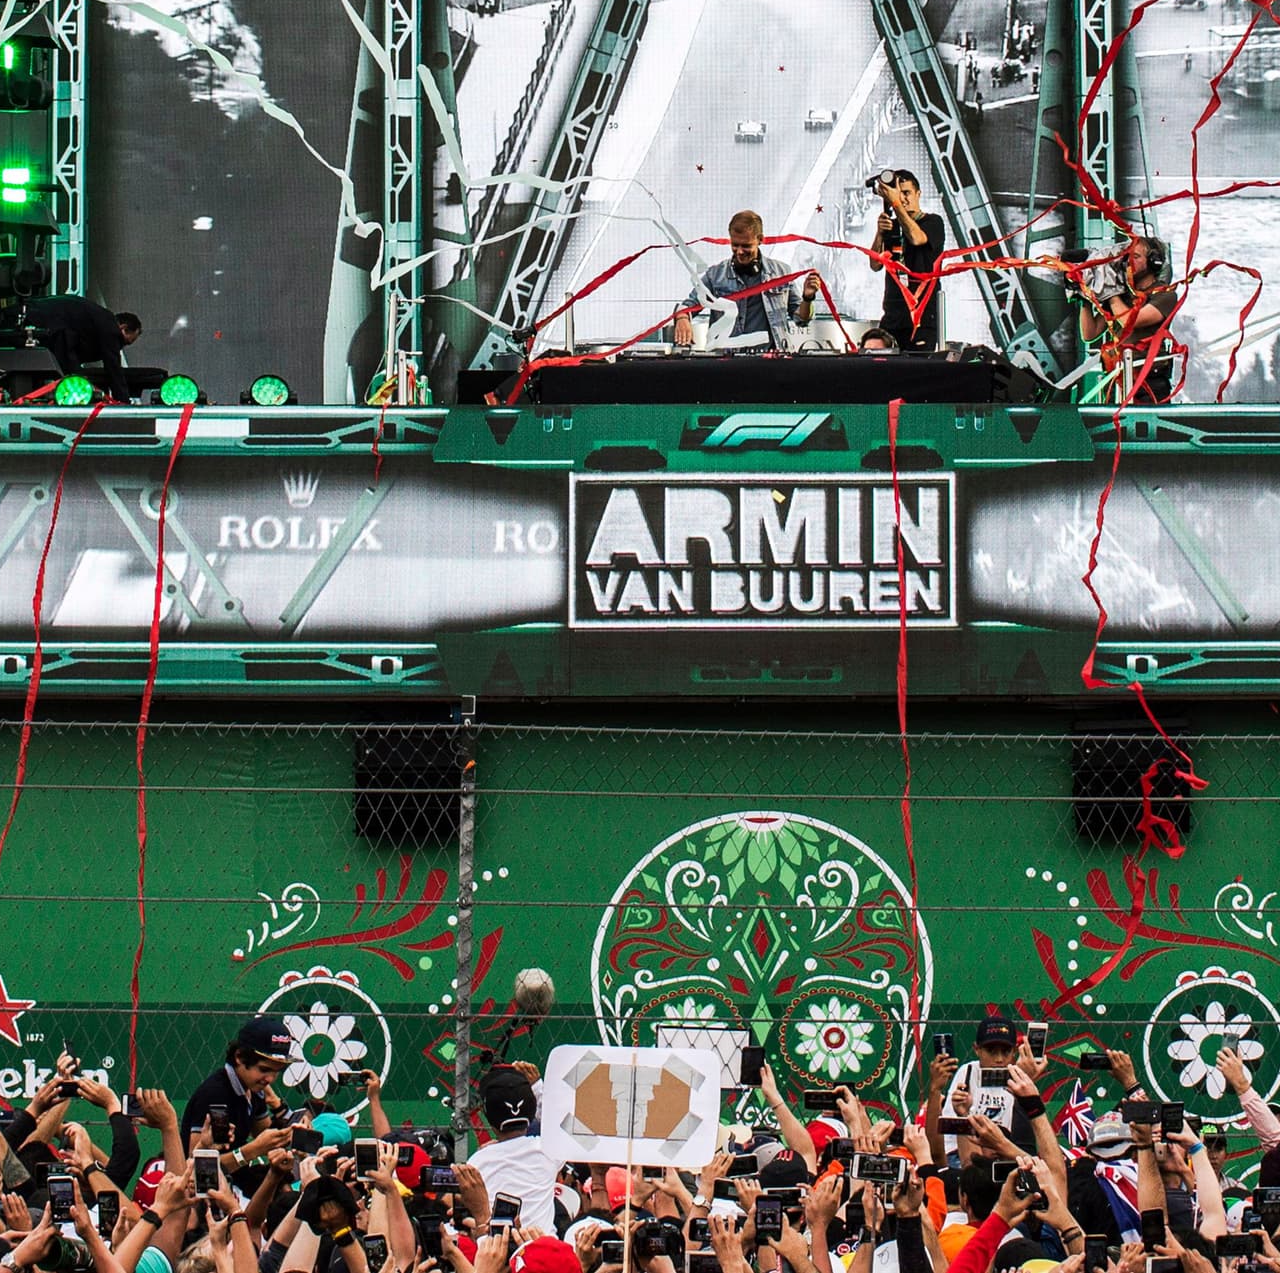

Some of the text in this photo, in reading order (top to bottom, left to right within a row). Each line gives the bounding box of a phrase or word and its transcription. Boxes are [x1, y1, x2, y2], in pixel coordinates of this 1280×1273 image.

[585, 486, 944, 567] ARMIN
[585, 570, 943, 614] VAN BUUREN
